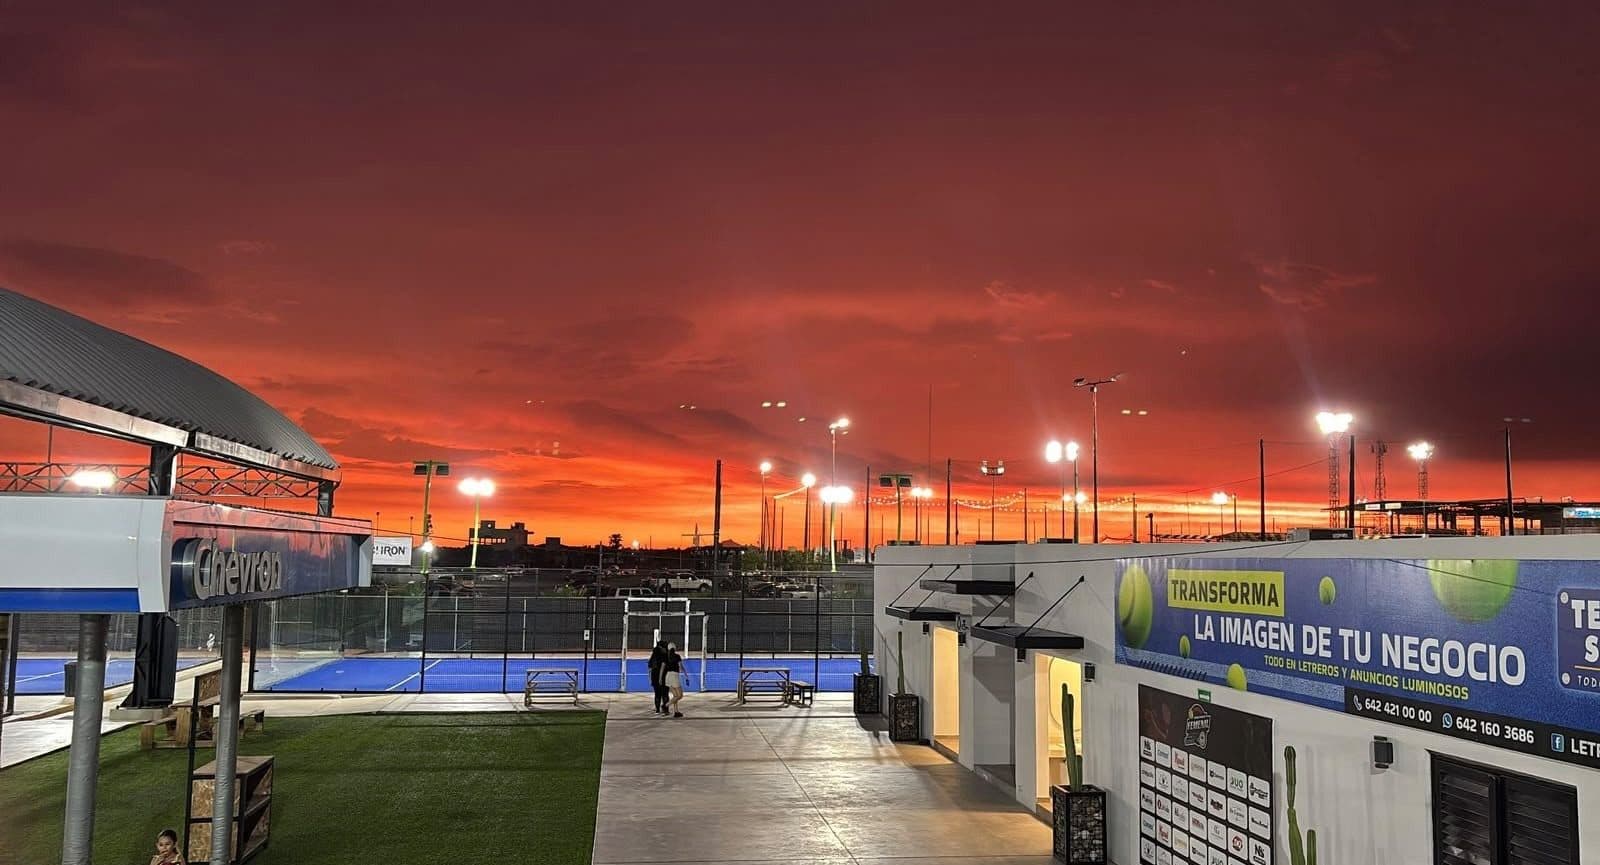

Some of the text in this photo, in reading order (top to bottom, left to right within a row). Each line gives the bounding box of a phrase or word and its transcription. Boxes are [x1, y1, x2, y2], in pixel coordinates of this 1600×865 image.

[193, 538, 281, 600] Chevron
[1171, 579, 1280, 608] TRANSFORMA
[1571, 599, 1600, 630] TE
[1194, 613, 1526, 687] LA IMAGEN DE TU NEGOCIO
[1264, 654, 1469, 700] TODO EN LETREROS Y ANUNCIOS LUMINOSOS
[1577, 674, 1600, 688] TOD
[1365, 698, 1432, 723] 642 421 00 00
[1456, 716, 1535, 744] 642 160 3686
